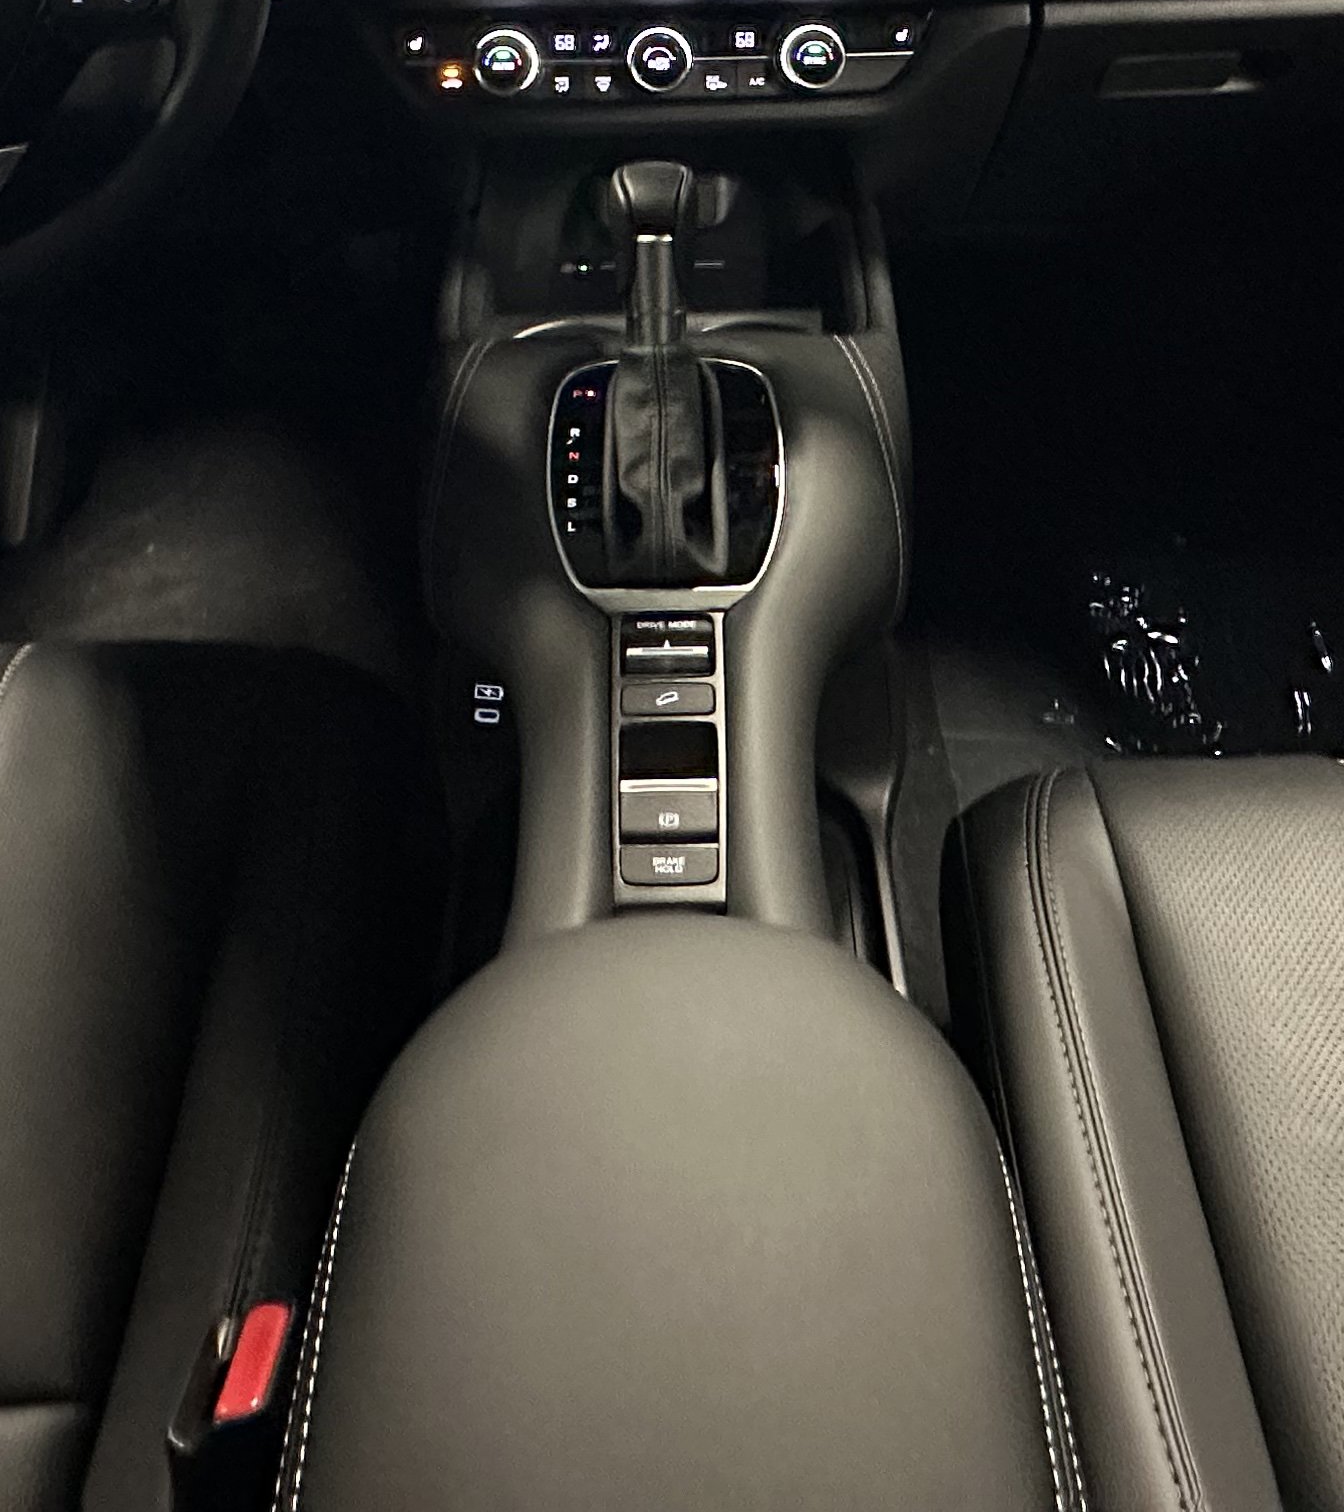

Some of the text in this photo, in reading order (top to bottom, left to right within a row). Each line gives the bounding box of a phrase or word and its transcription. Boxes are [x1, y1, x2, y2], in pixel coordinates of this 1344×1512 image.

[748, 77, 766, 87] A/C
[569, 427, 581, 438] R
[568, 452, 580, 460] N
[567, 474, 579, 484] D
[567, 497, 577, 508] S
[567, 521, 577, 532] L
[668, 620, 696, 630] MODE
[652, 856, 686, 866] BRAKE
[655, 864, 684, 874] HOLD
